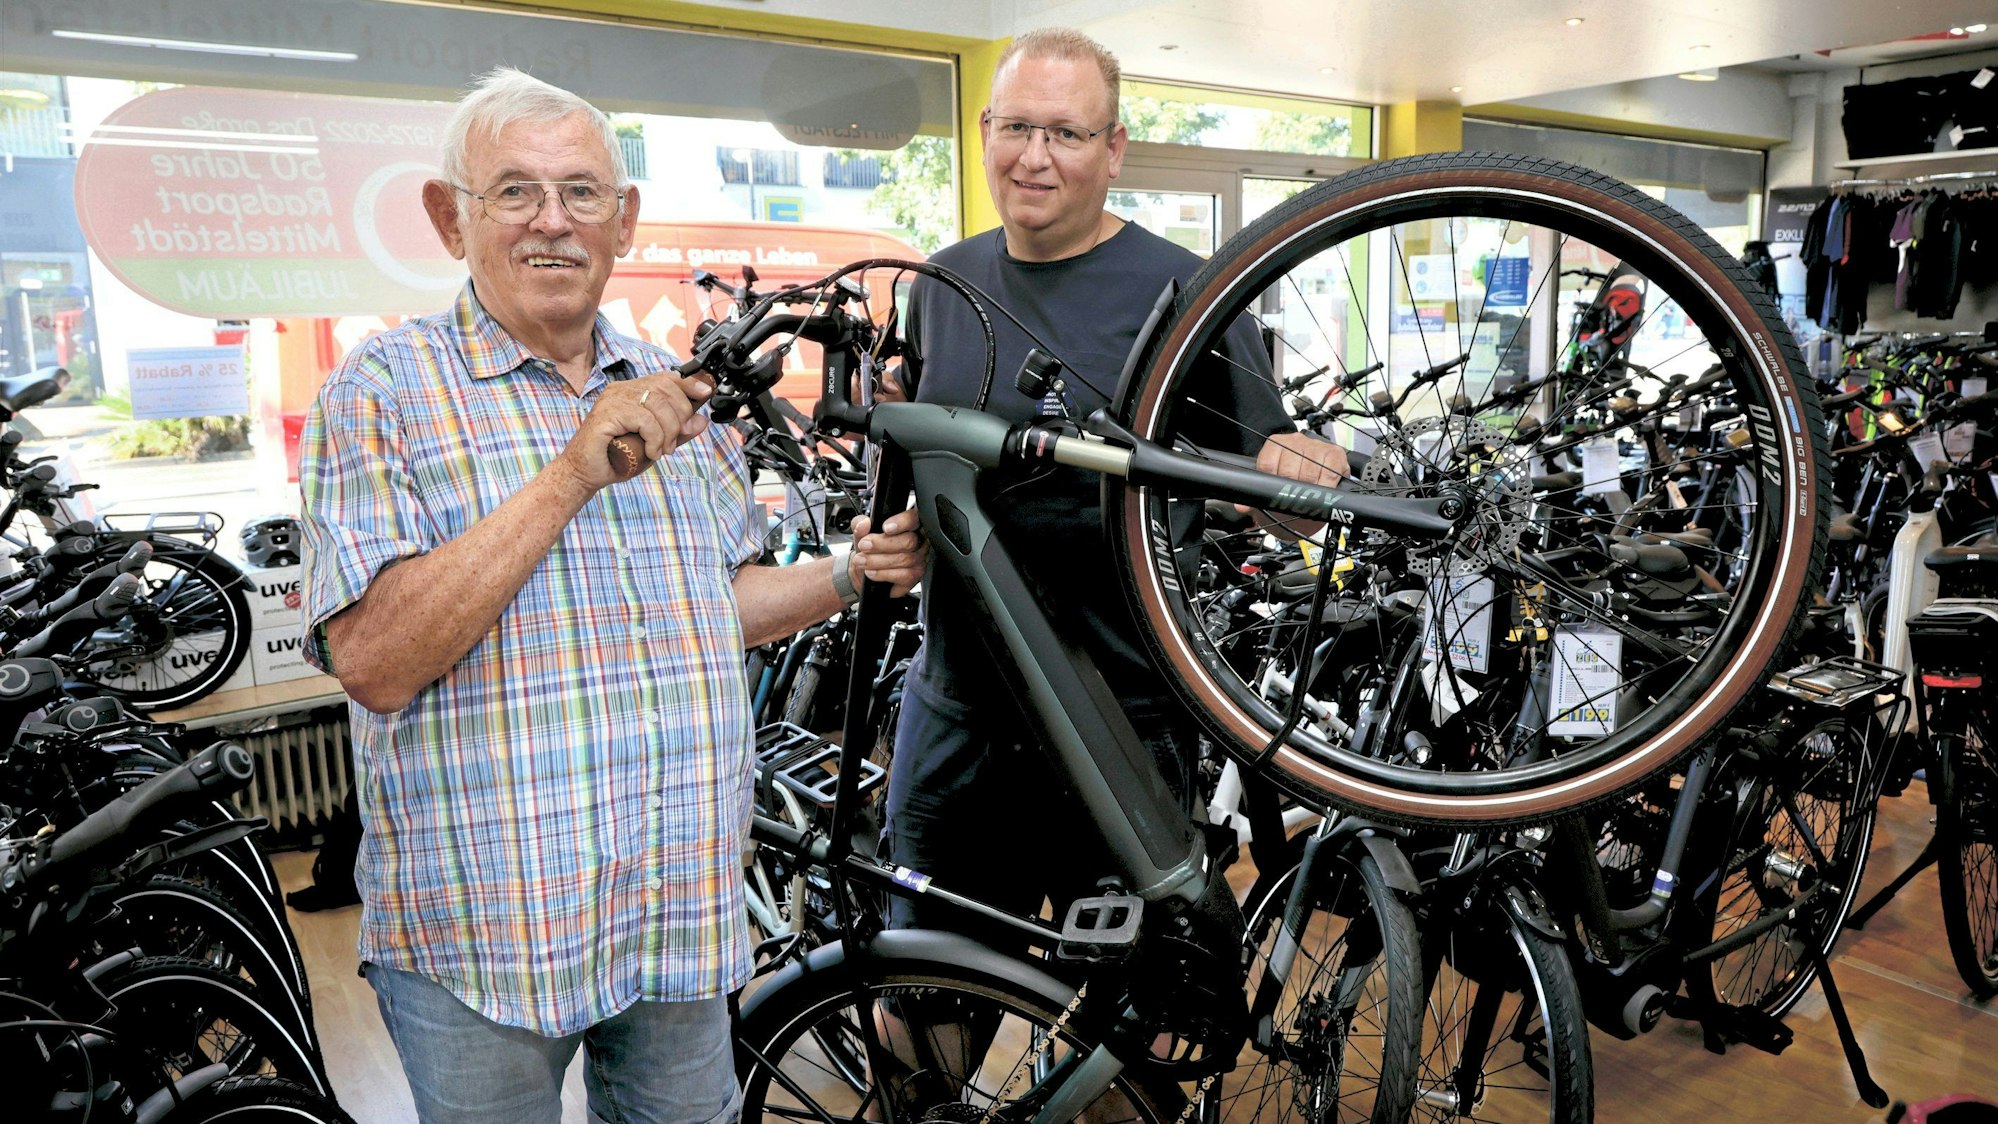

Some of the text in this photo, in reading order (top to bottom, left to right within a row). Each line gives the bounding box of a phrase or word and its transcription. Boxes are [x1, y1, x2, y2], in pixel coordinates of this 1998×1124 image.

[642, 243, 681, 263] das
[687, 248, 751, 267] ganze
[756, 246, 818, 265] Leben
[1753, 332, 1788, 392] SCHWALBE
[1795, 436, 1805, 457] BIG
[1330, 508, 1355, 524] AIR
